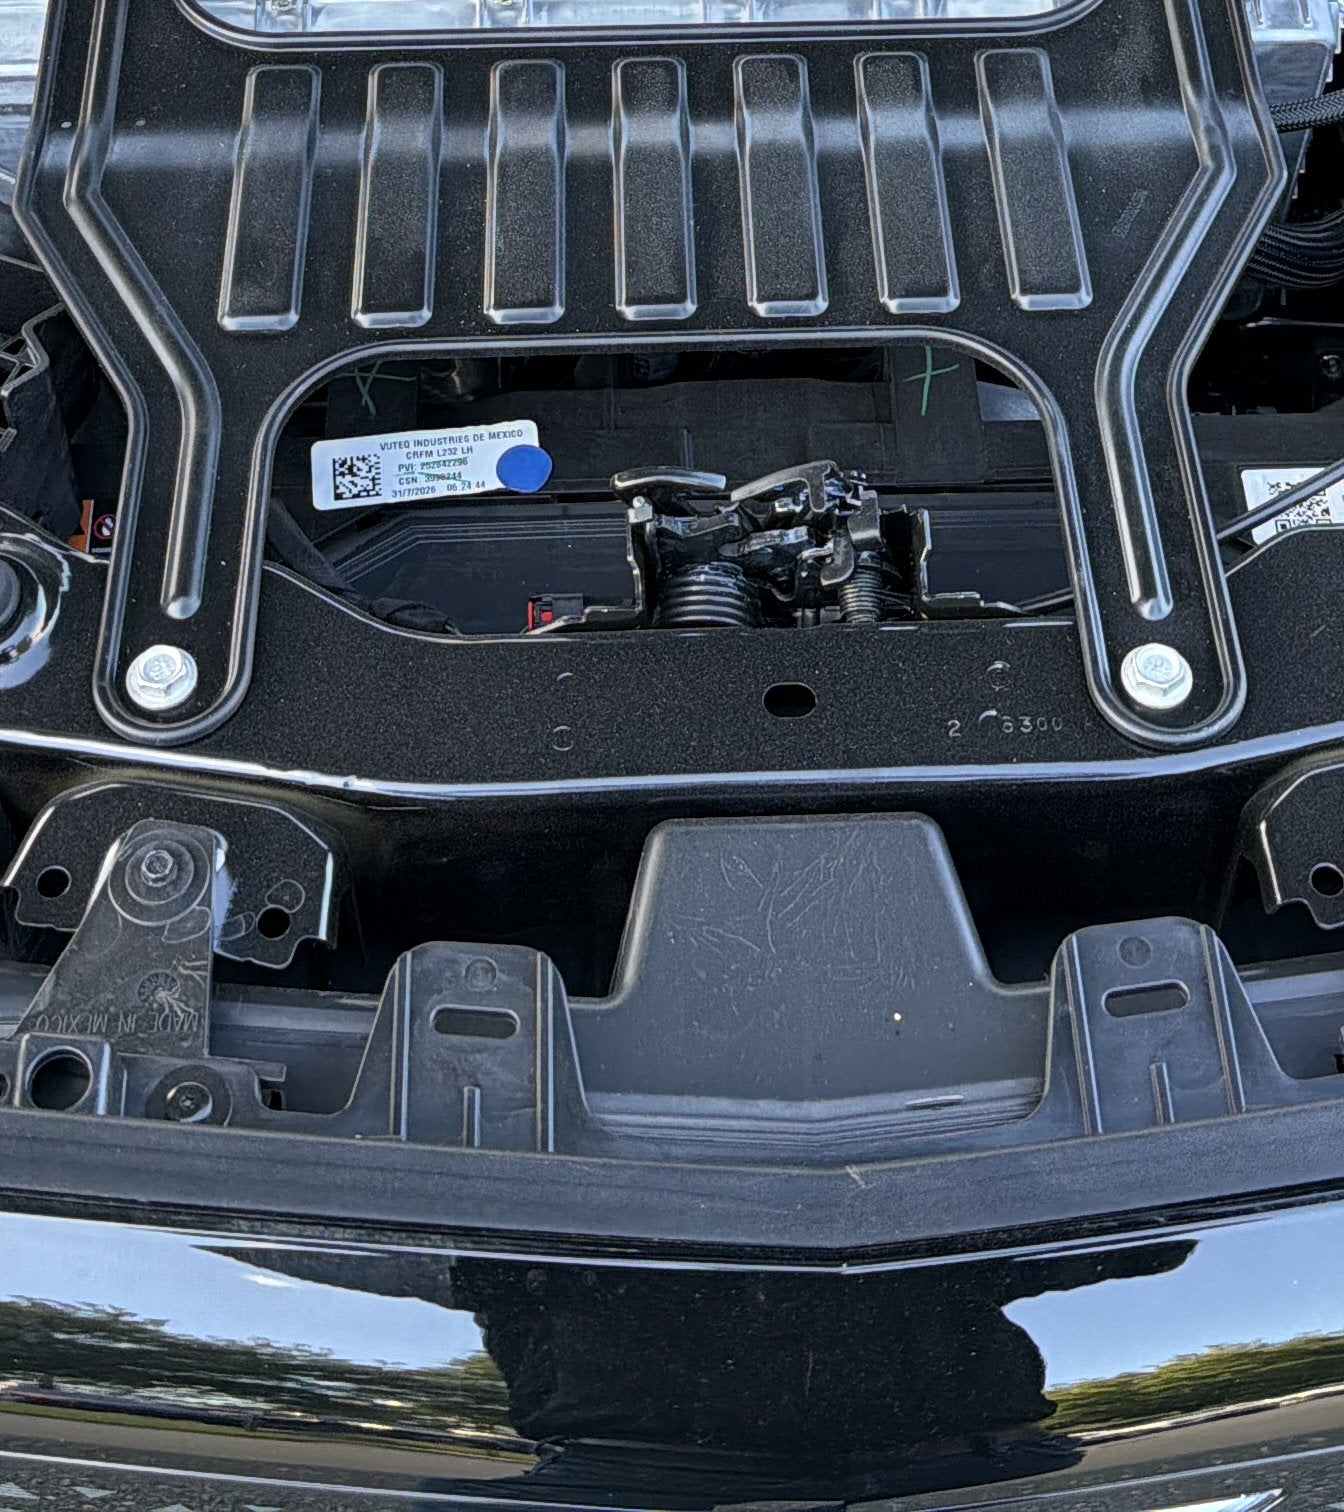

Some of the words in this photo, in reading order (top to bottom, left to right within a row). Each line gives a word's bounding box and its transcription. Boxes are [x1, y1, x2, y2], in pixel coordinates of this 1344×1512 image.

[380, 441, 410, 451] VUTEQ
[413, 435, 470, 448] INDUSTRIES
[473, 433, 485, 442] DE
[488, 429, 524, 440] MEXICO
[406, 449, 433, 460] CRFM
[437, 447, 458, 457] L232
[461, 445, 474, 455] LH
[392, 487, 436, 498] 31/7/2026
[35, 1012, 107, 1033] MEXICO
[118, 1011, 137, 1033] IN
[148, 1011, 199, 1032] MADE
